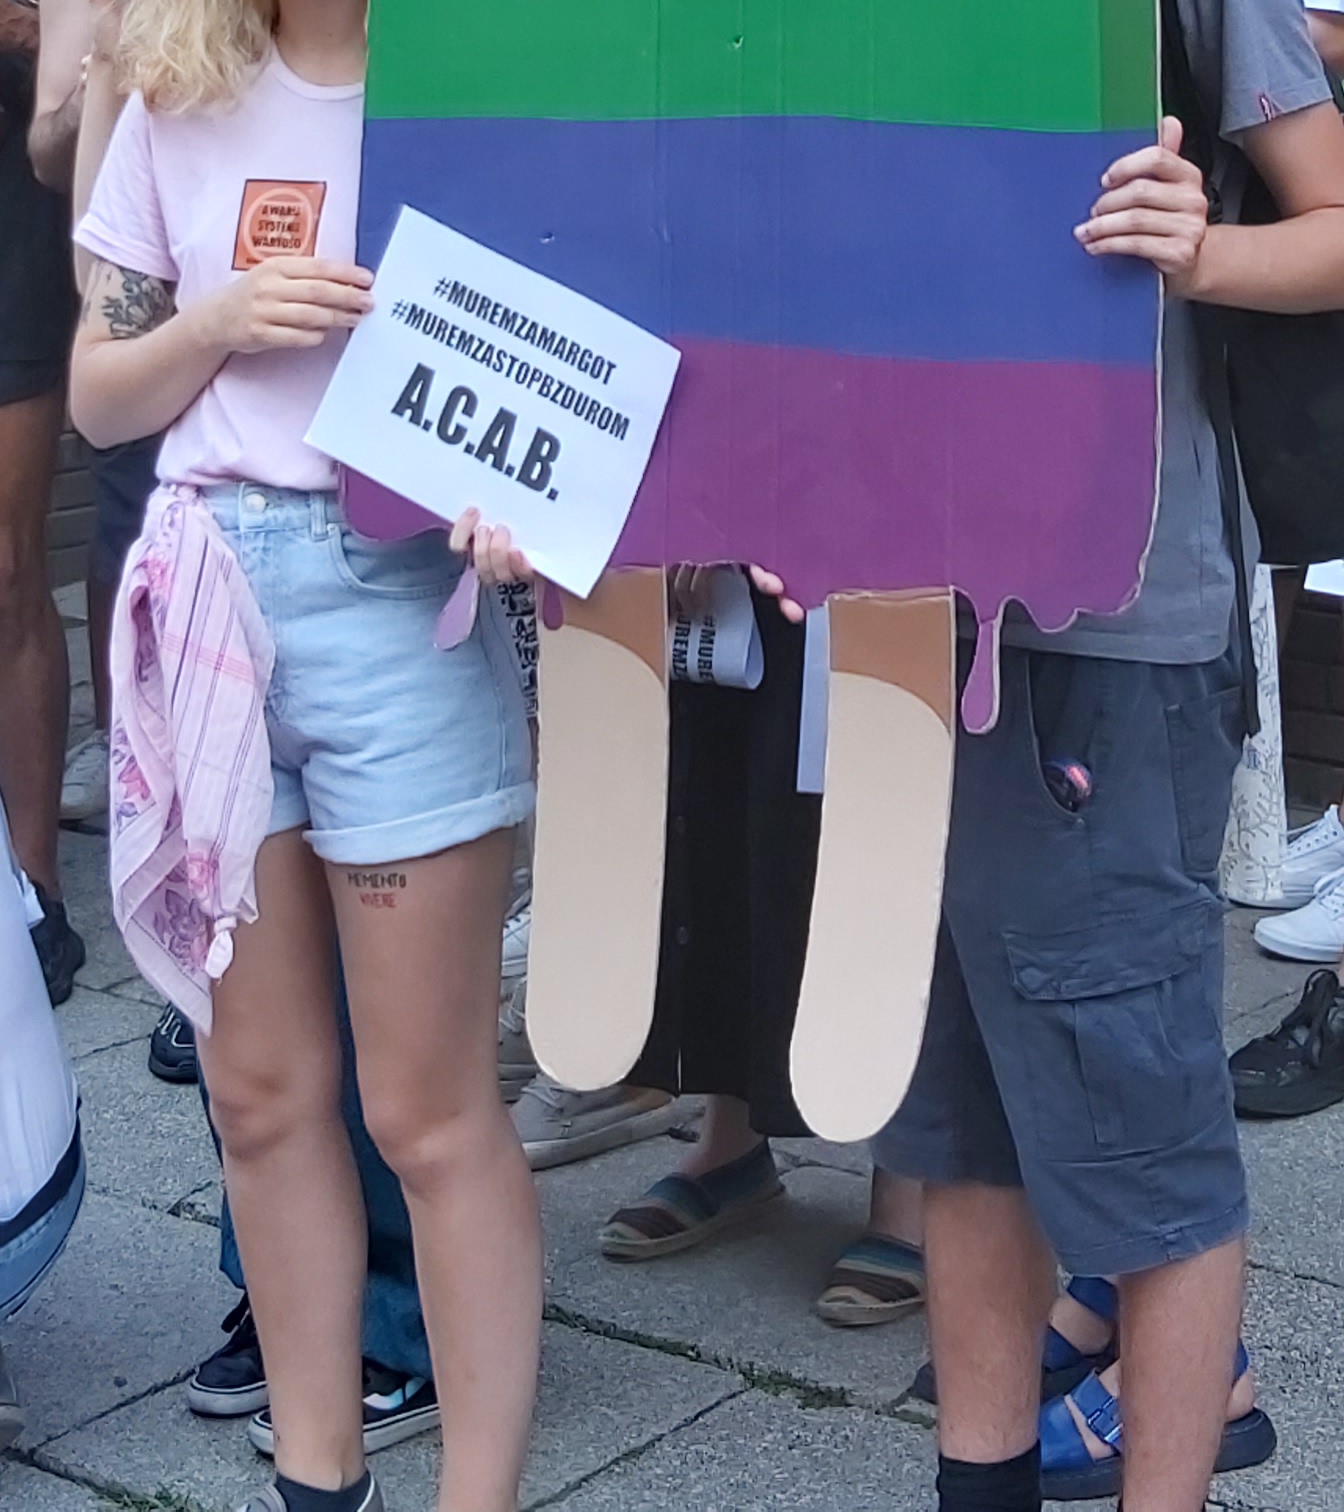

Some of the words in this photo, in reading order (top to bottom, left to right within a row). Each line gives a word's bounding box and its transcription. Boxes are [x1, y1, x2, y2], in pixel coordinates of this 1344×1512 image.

[390, 299, 631, 441] #MUREMZASTOPBZDUROM
[434, 277, 617, 385] #MUREMZAMARGOT
[391, 362, 562, 501] A.C.A.B.
